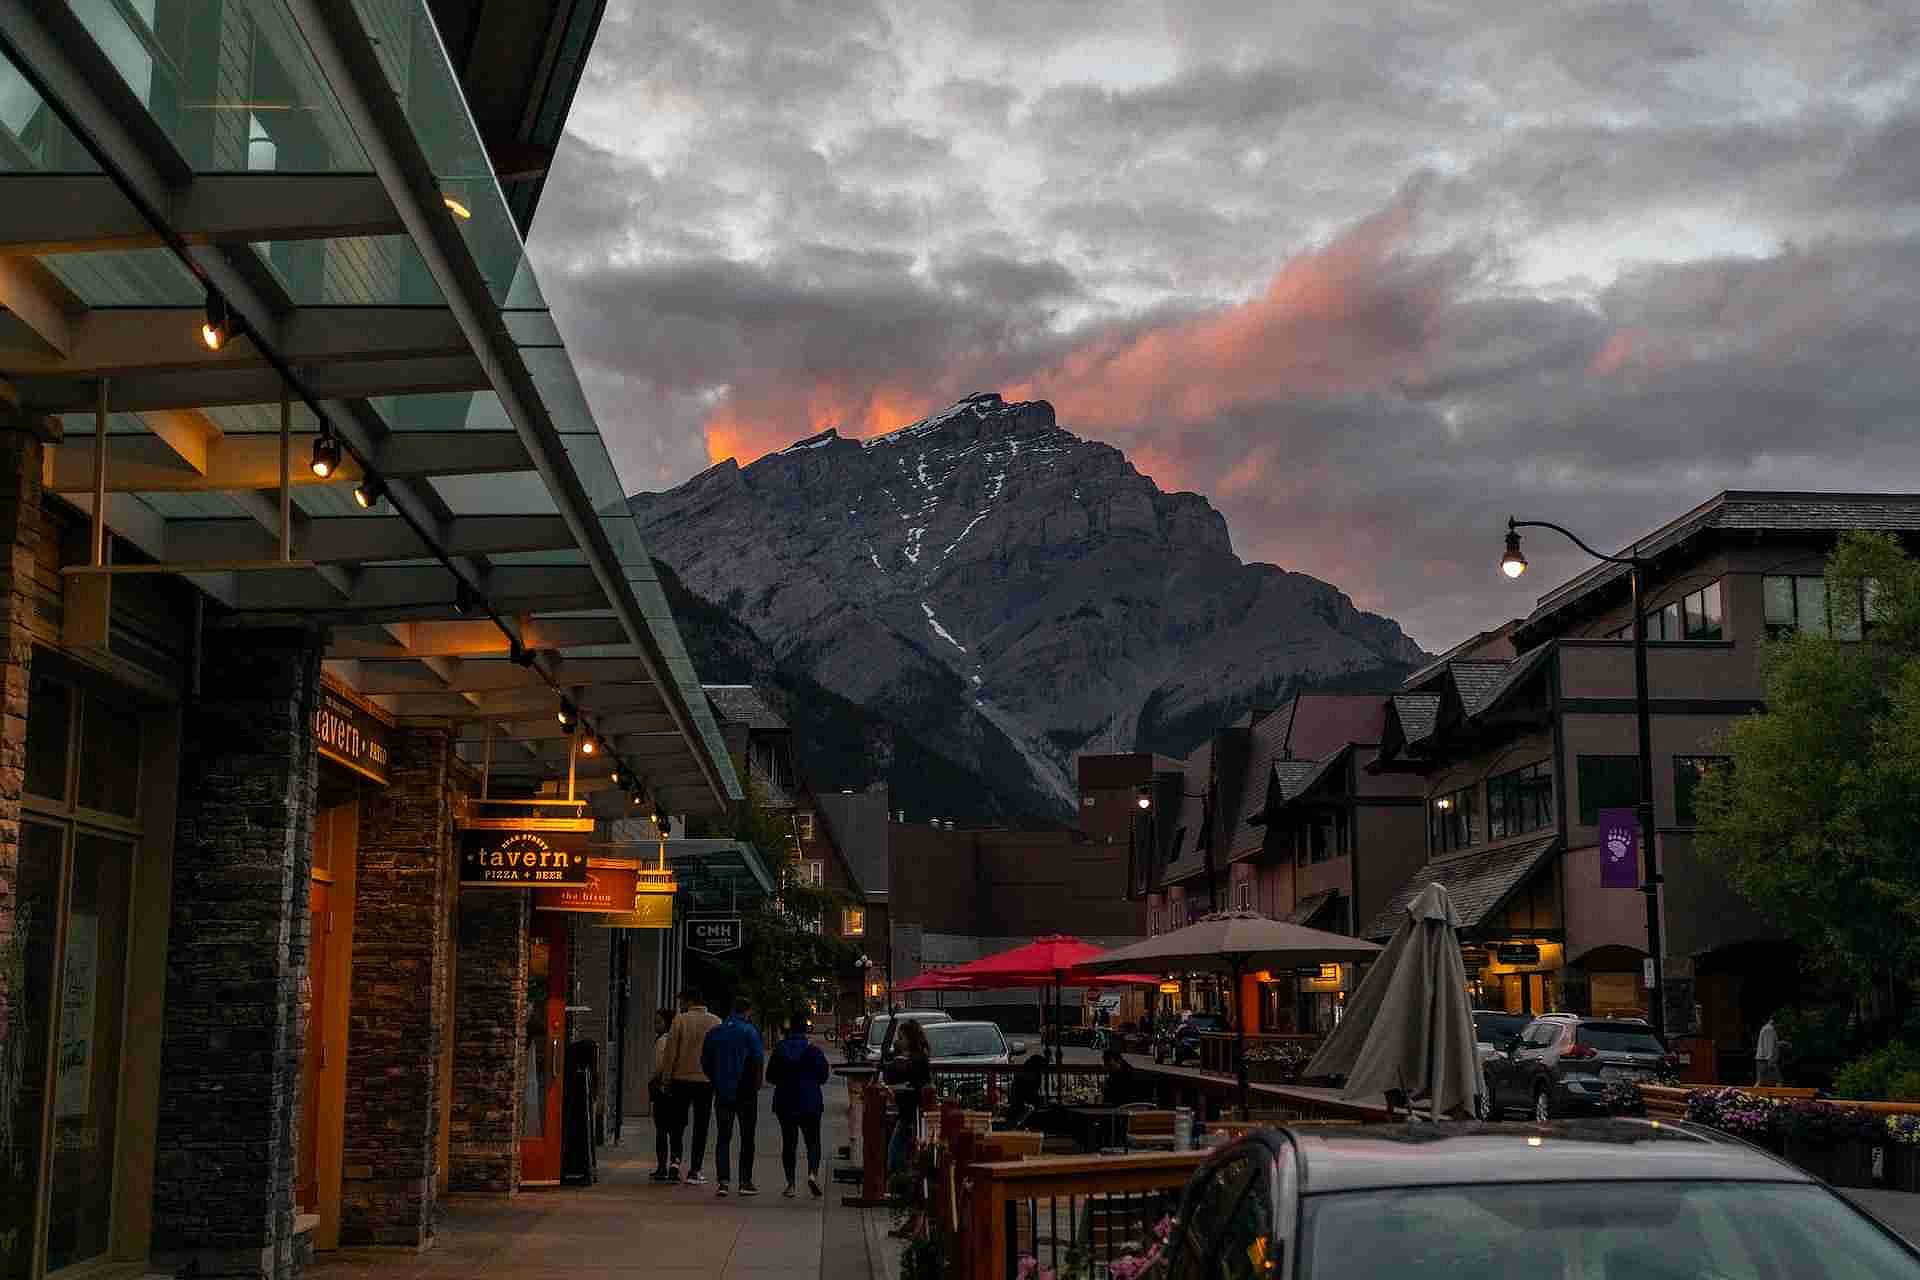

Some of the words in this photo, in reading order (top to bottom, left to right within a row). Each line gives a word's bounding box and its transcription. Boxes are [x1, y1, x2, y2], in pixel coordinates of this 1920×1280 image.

[314, 708, 360, 760] tavern
[479, 847, 569, 867] tavern
[484, 871, 518, 880] PIZZA
[535, 871, 562, 880] BEER
[696, 924, 731, 937] CMH
